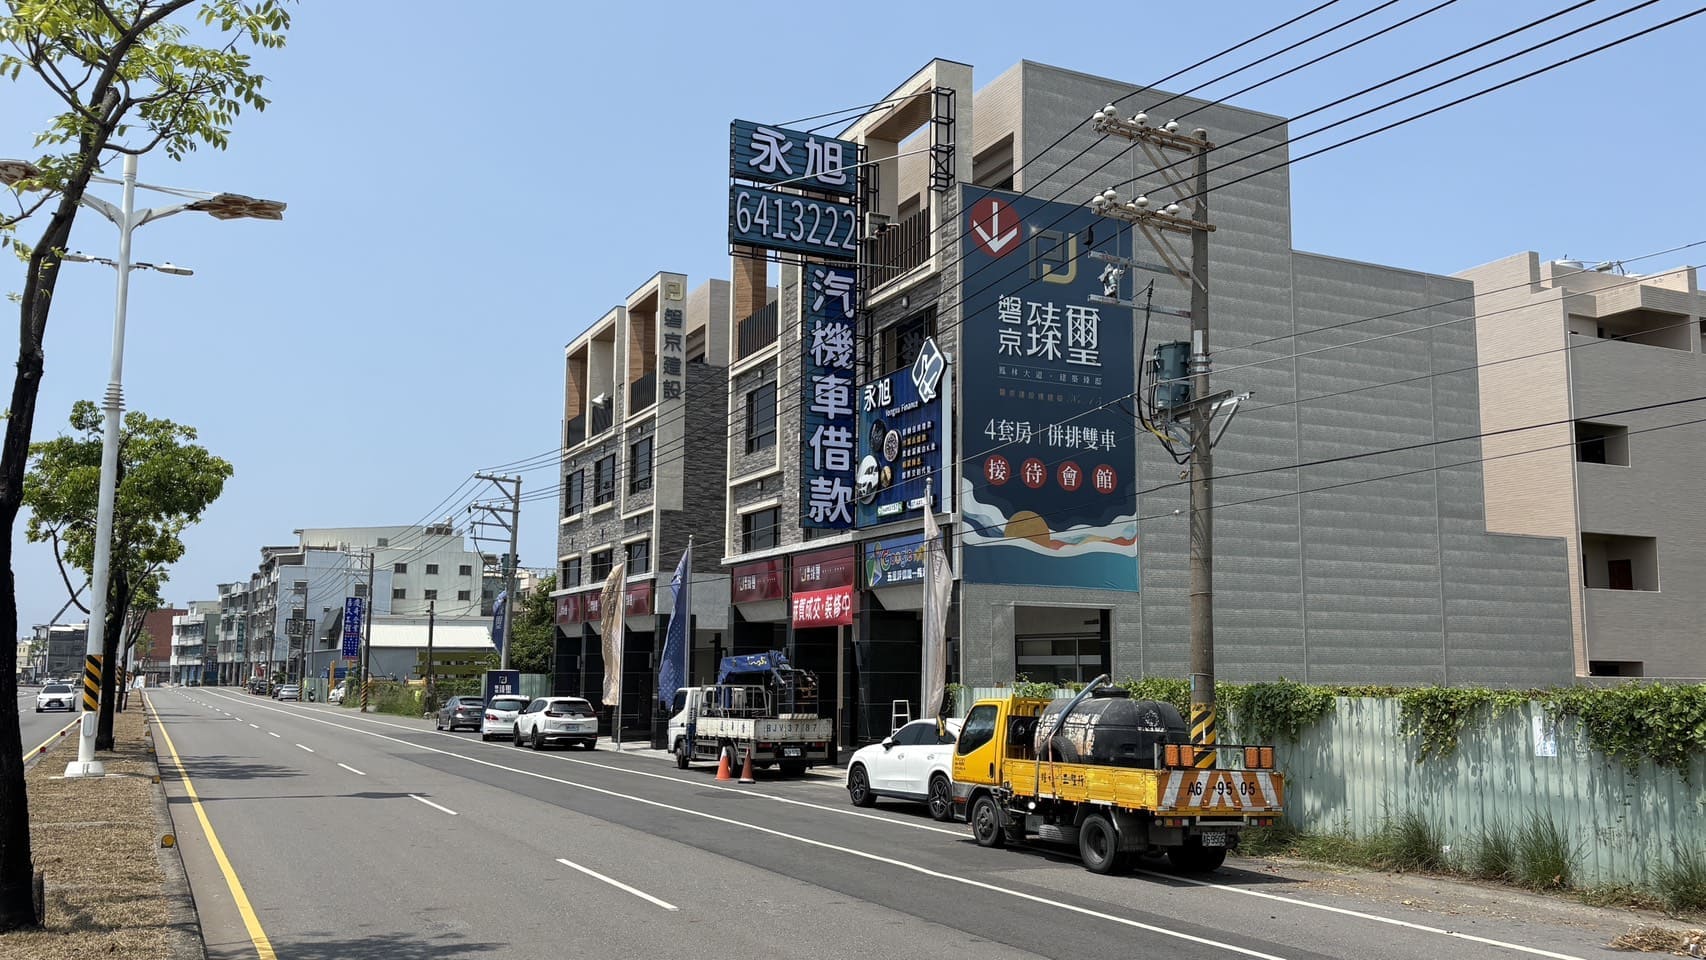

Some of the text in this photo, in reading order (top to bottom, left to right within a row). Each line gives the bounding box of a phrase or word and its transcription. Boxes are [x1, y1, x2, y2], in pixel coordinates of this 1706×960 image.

[749, 126, 847, 186] 永旭
[736, 190, 856, 251] 6413222
[809, 269, 855, 525] 汽機車借款
[864, 377, 892, 412] 永旭
[984, 418, 1117, 452] 4套房 併排雙車
[988, 459, 1113, 490] 接待會館
